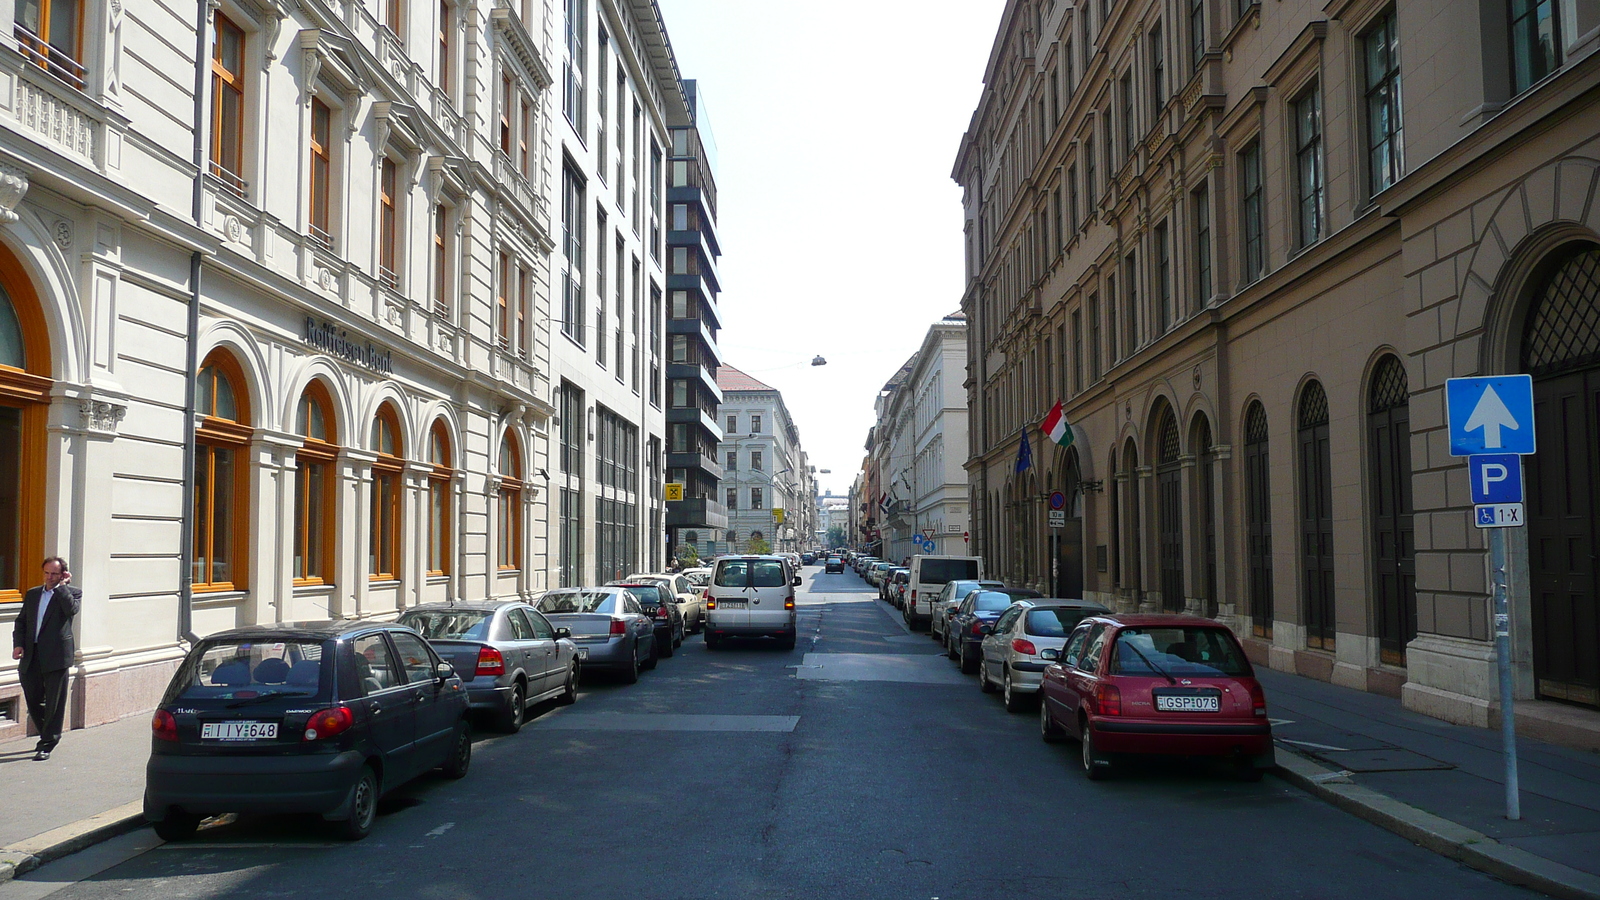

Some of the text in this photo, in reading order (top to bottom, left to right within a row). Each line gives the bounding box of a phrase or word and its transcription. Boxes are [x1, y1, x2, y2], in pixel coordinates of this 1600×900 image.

[307, 316, 394, 374] Raiffeisen Bank
[1481, 463, 1508, 495] P
